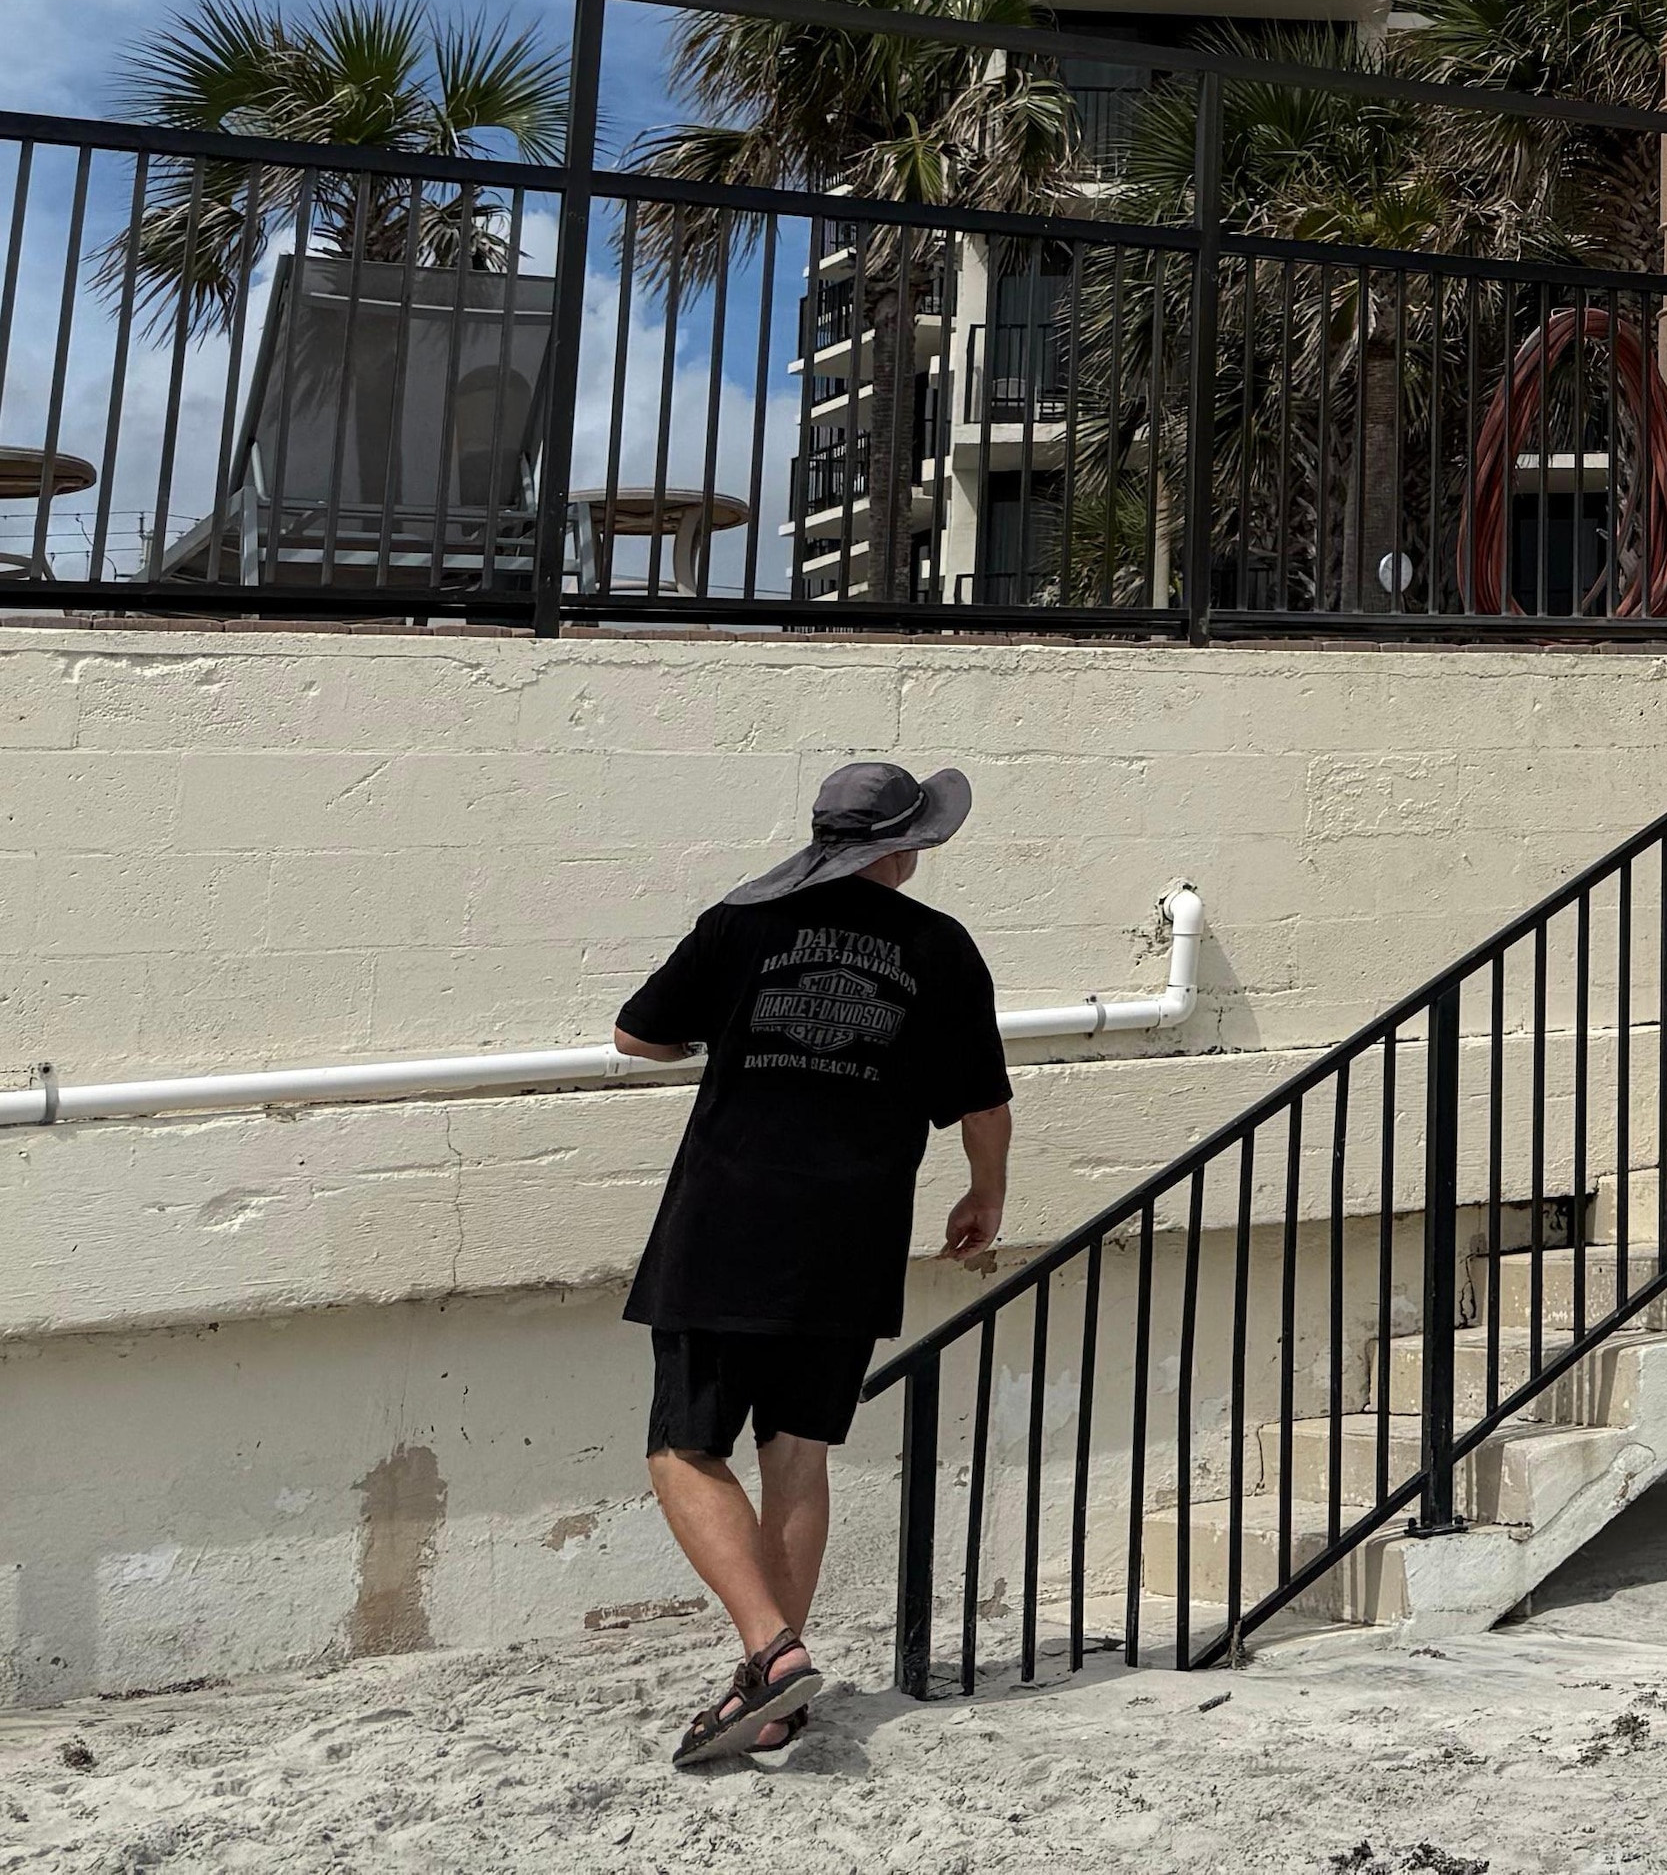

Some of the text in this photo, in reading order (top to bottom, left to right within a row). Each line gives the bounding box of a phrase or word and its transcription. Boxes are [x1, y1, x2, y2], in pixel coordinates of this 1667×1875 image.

[792, 927, 902, 967] DAYTONA
[760, 948, 919, 995] HARLEY-DAVIDSON
[759, 996, 897, 1033] HARLEY-DAVIDSON
[744, 1054, 807, 1069] DAYTONA
